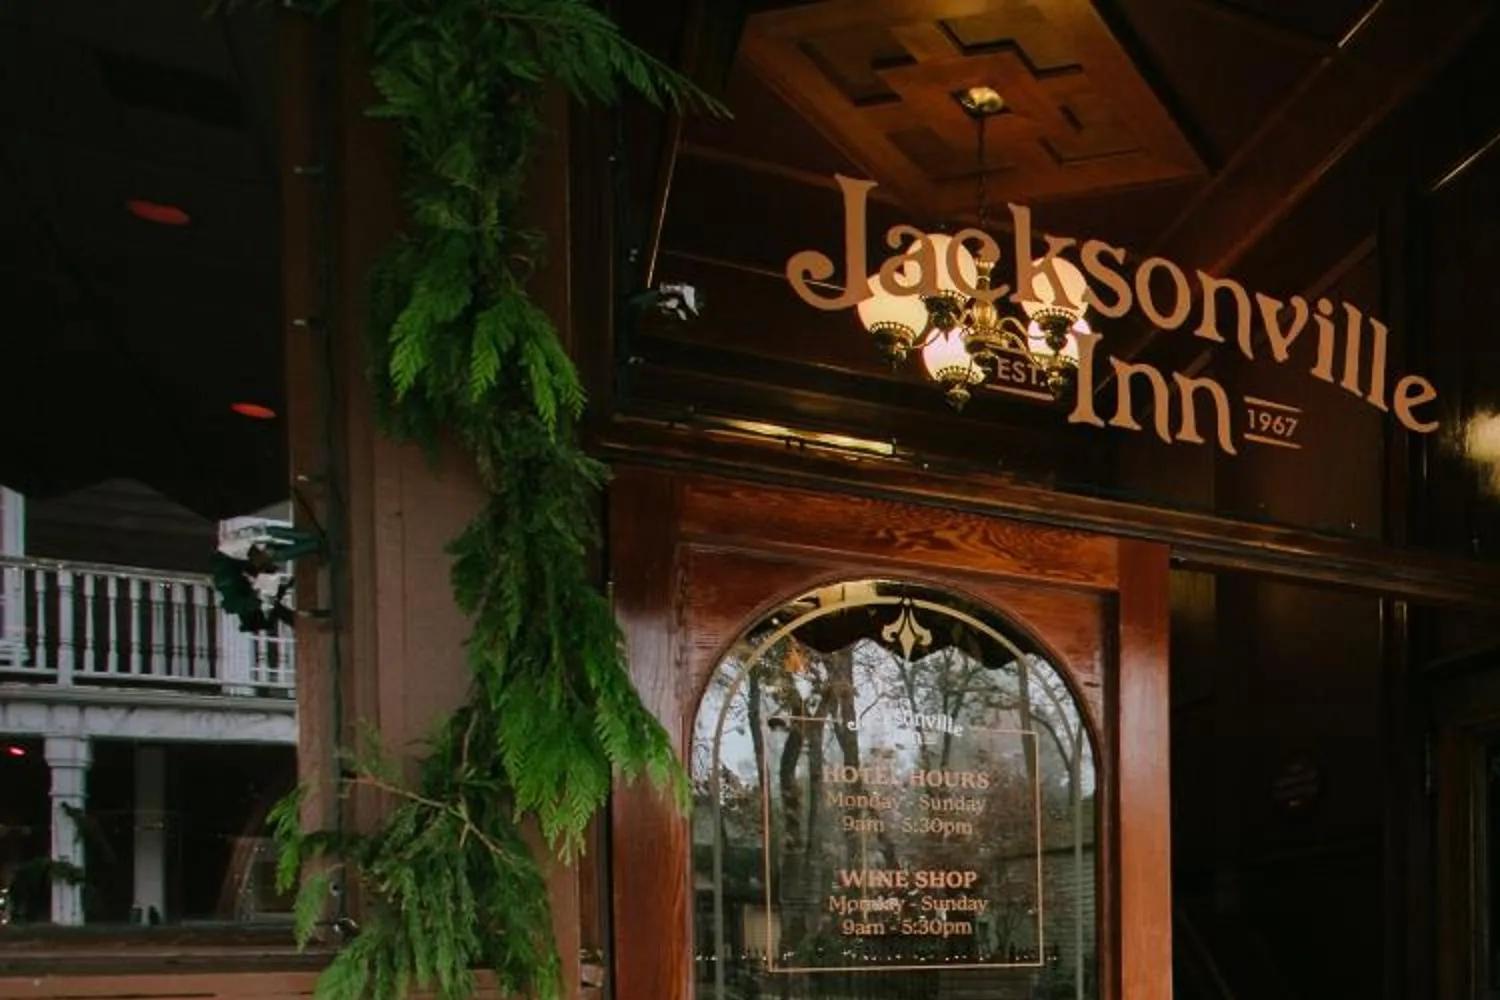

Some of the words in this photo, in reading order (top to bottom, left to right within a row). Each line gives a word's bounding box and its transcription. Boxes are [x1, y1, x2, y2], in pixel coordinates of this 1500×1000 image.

[785, 173, 1439, 433] Jacksonville
[996, 356, 1048, 388] EST.
[1068, 332, 1237, 456] Inn
[1247, 408, 1297, 438] 1967
[822, 765, 899, 785] HOTEL
[908, 769, 990, 789] HOURS
[826, 791, 902, 811] Monday
[919, 795, 986, 814] Sunday
[843, 816, 885, 832] 9am
[902, 817, 973, 837] 5:30pm
[839, 869, 909, 888] WINE
[915, 871, 977, 888] SHOP
[921, 896, 988, 914] Sunday
[843, 919, 885, 935] 9am
[902, 919, 972, 938] 5:30pm
